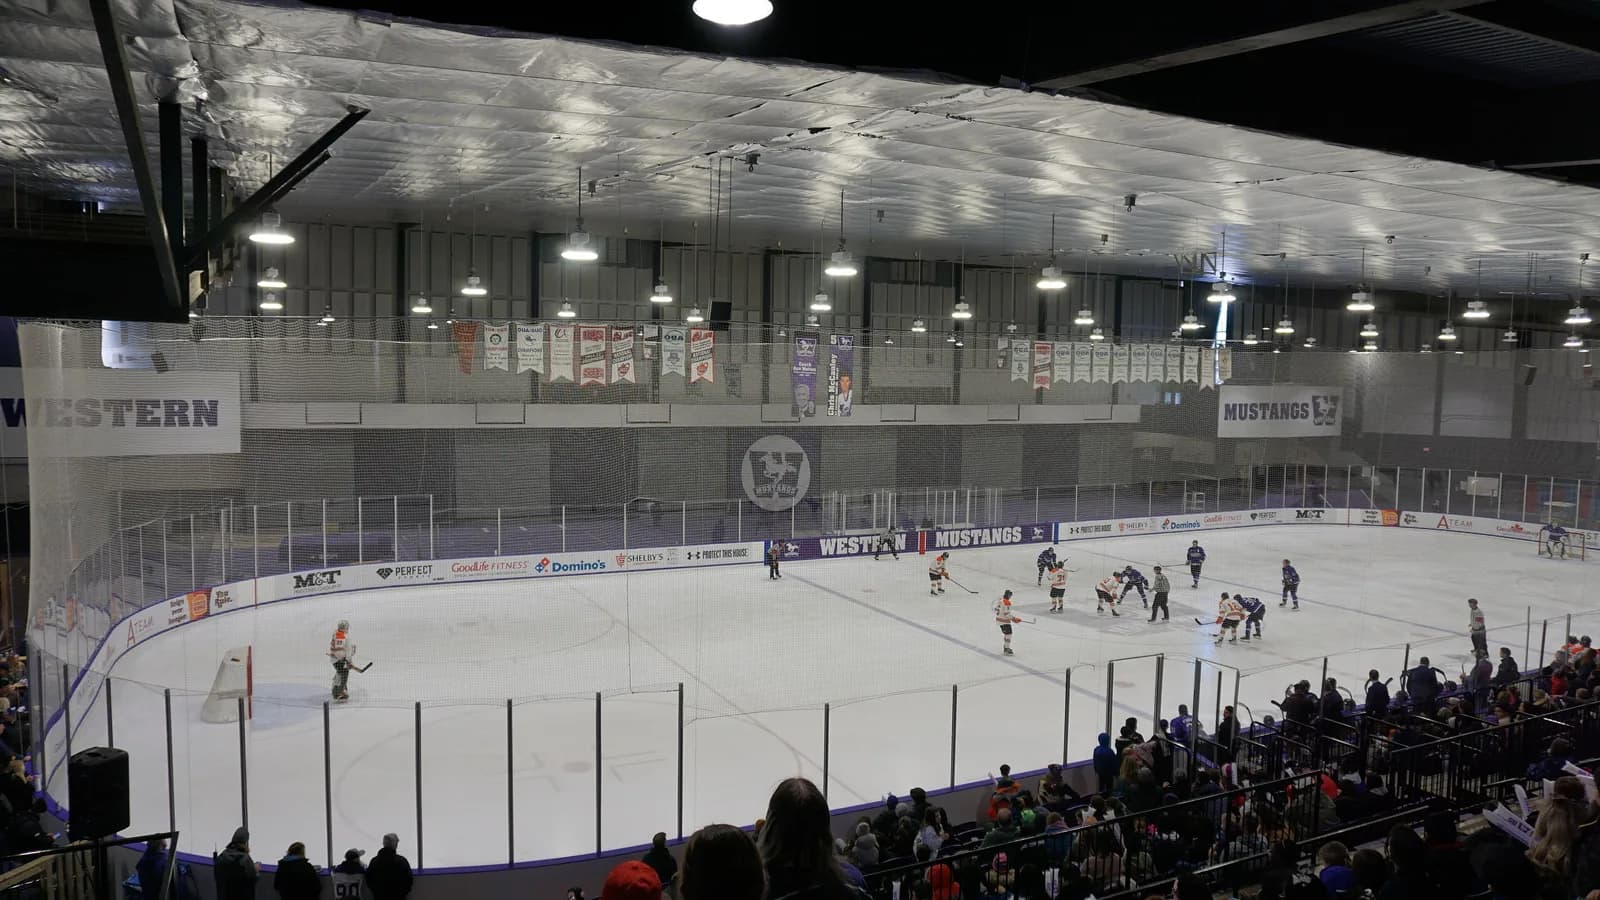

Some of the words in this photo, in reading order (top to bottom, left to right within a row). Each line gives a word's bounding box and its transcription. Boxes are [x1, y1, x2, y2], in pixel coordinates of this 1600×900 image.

[0, 398, 219, 428] WESTERN
[1224, 402, 1310, 421] MUSTANGS
[1170, 520, 1201, 530] Domino's
[936, 527, 1022, 548] MUSTANGS
[627, 553, 664, 563] SHELBY'S
[395, 565, 433, 577] PERFECT
[451, 561, 489, 573] GoodLife
[491, 561, 528, 571] FITNESS
[551, 560, 606, 573] Domino's
[293, 570, 342, 589] M&T
